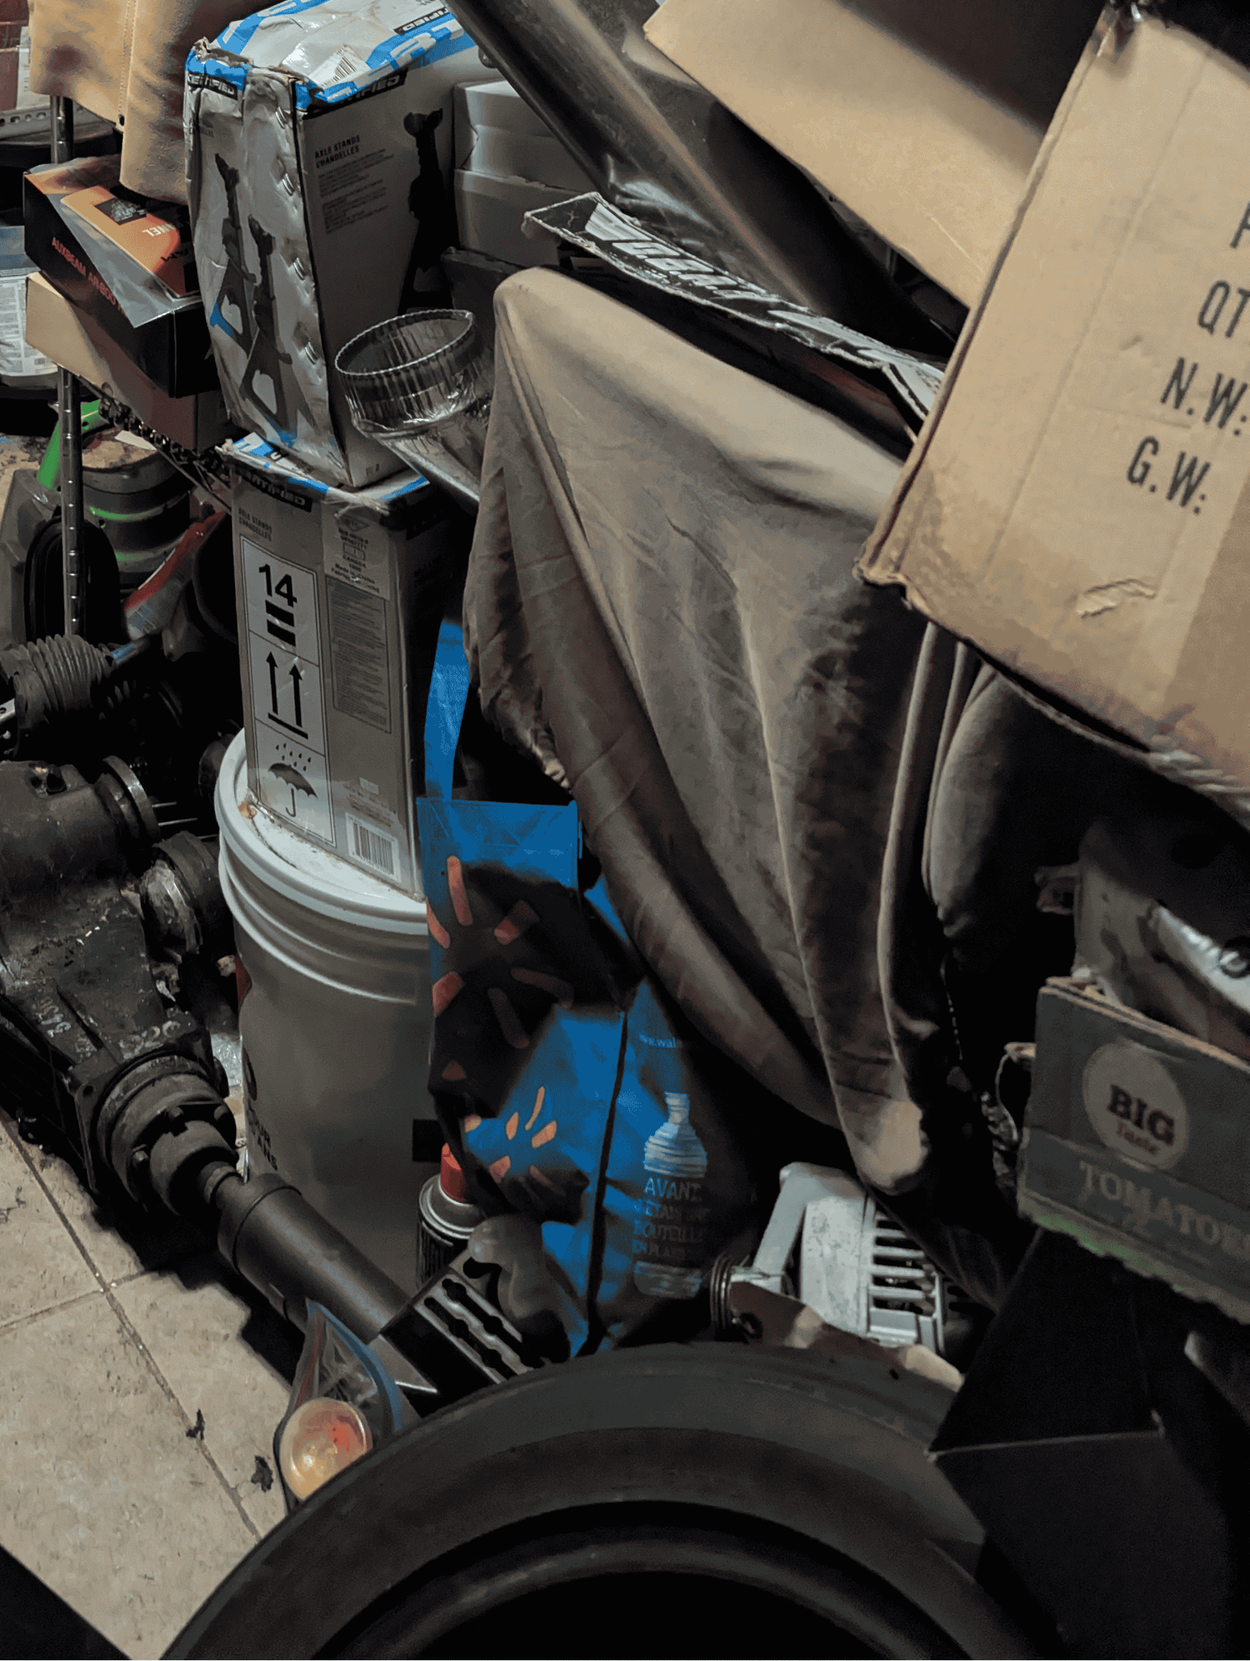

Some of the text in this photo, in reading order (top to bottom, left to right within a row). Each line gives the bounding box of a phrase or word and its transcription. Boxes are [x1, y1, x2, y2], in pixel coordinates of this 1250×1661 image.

[315, 134, 361, 159] AXLE STANDS
[51, 236, 87, 279] AUXBEAM
[1127, 436, 1211, 515] G.W:
[258, 563, 298, 609] 14
[1106, 1083, 1175, 1147] BIG
